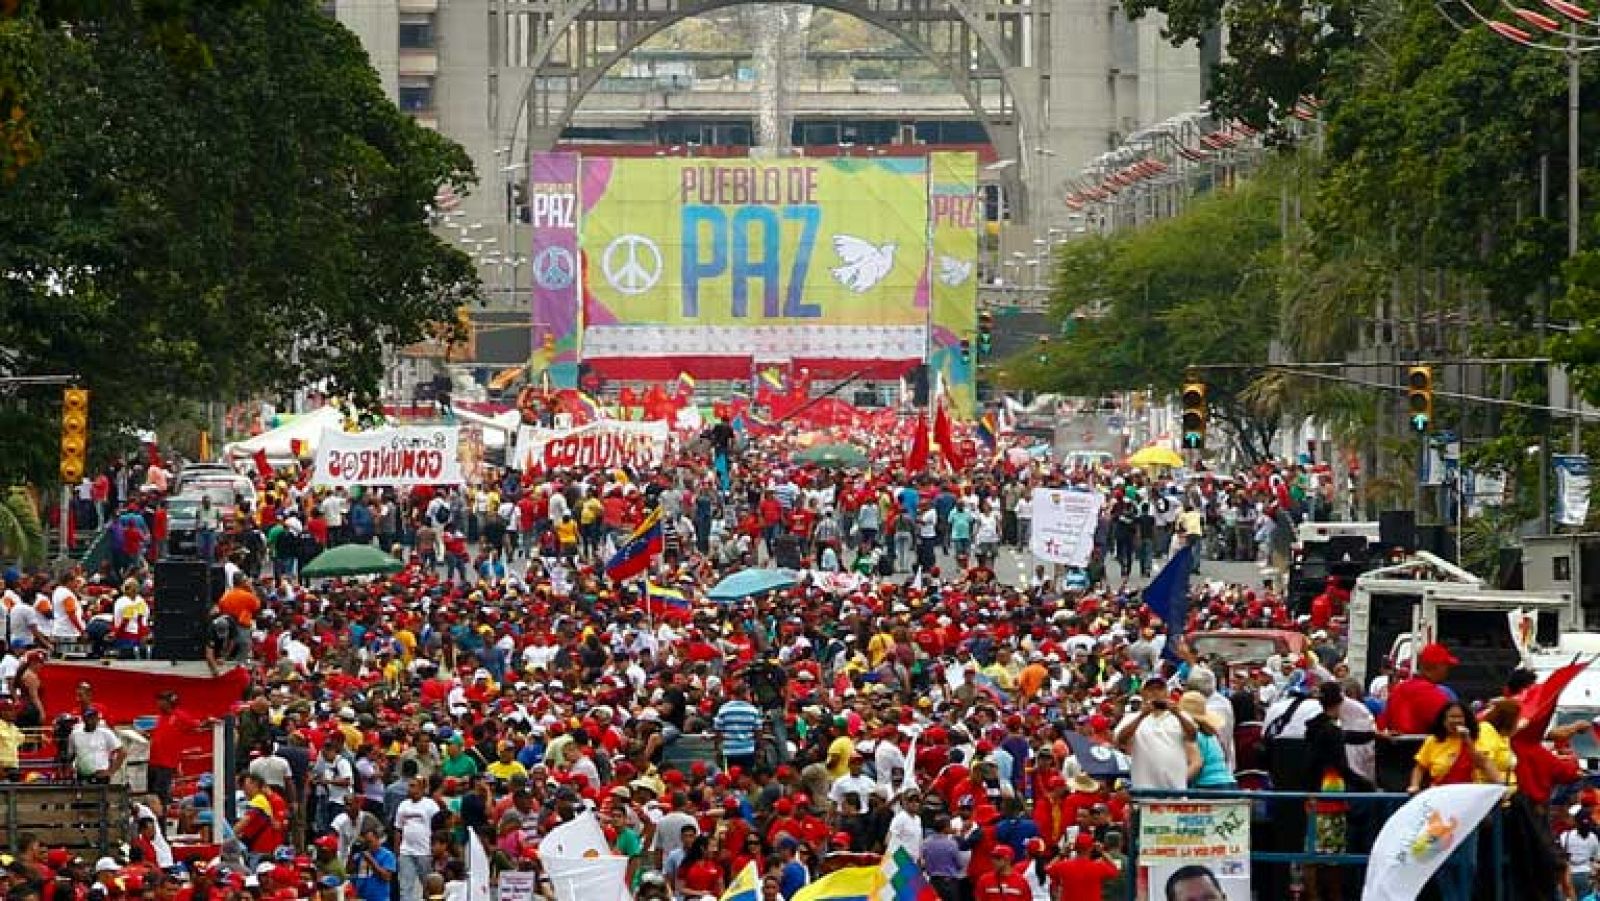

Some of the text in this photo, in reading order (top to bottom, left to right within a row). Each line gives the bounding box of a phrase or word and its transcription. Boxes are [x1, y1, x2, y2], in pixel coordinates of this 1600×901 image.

[681, 166, 818, 204] PUEBLO DE
[533, 194, 575, 227] PAZ
[933, 194, 976, 229] PAZ
[681, 204, 822, 318] PAZ
